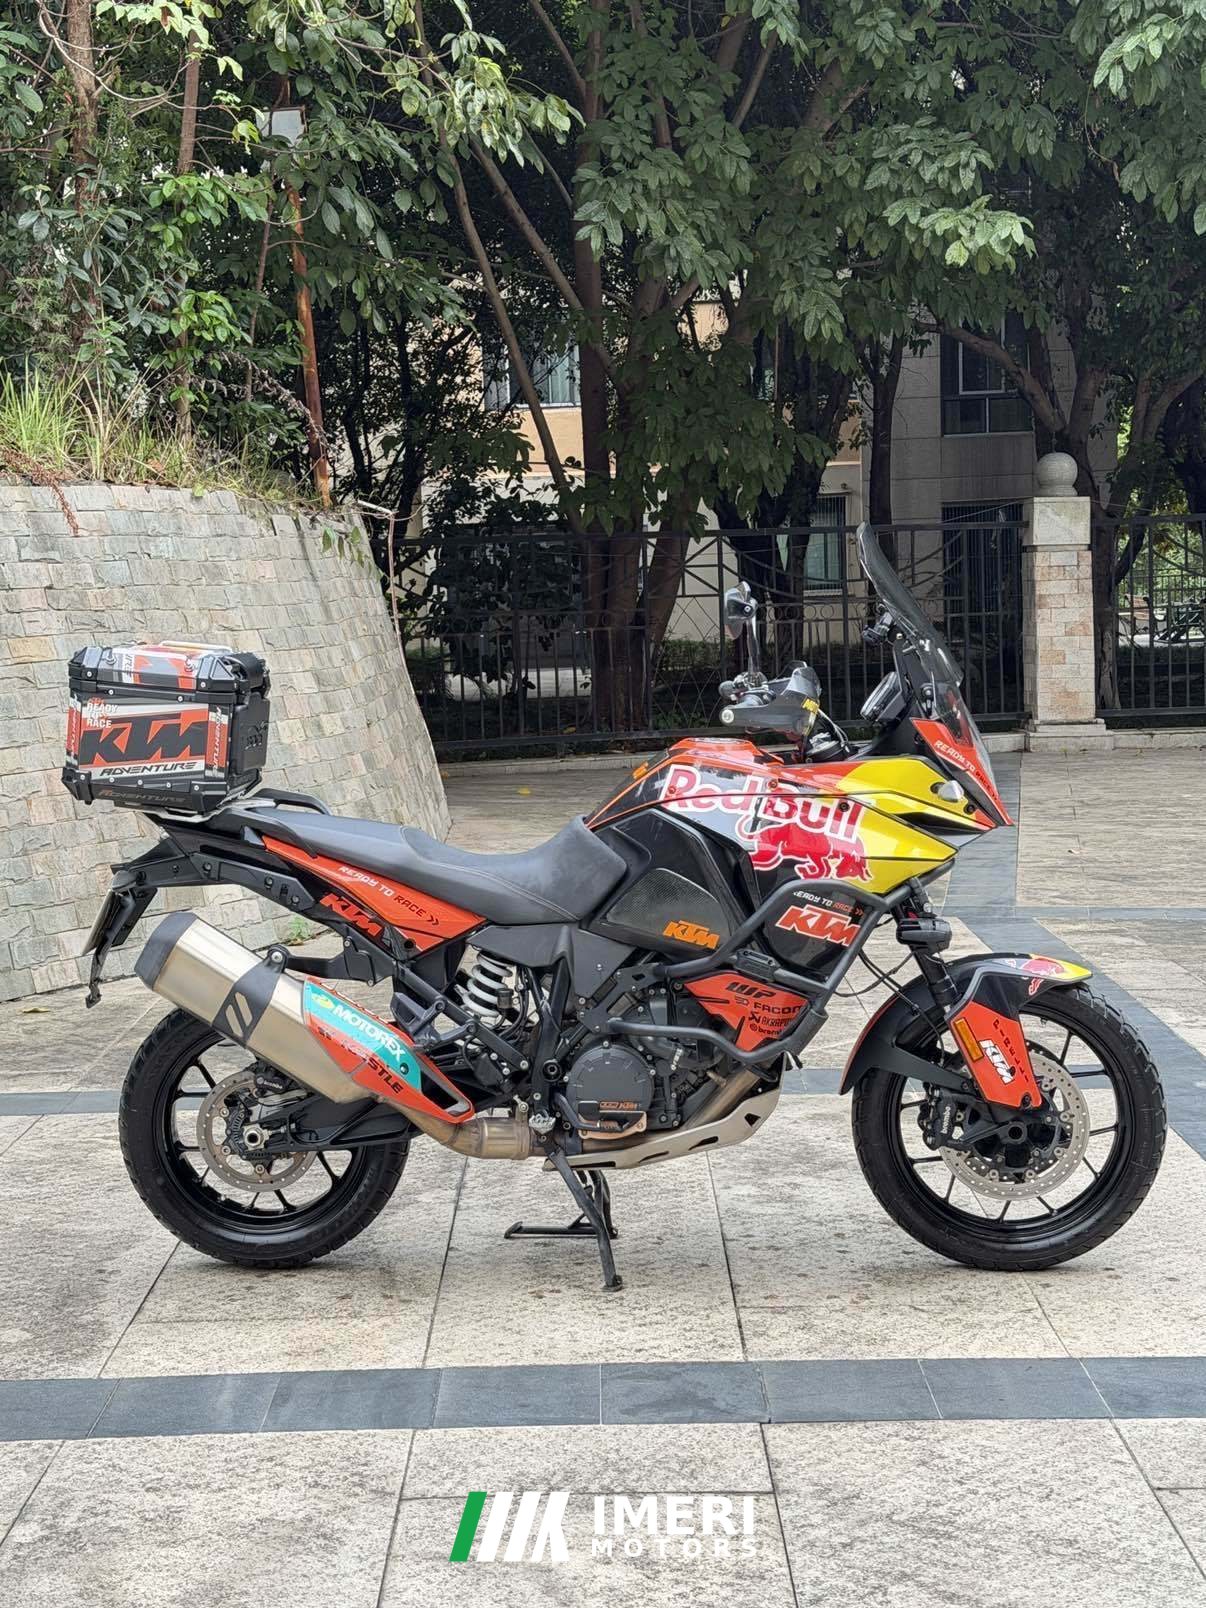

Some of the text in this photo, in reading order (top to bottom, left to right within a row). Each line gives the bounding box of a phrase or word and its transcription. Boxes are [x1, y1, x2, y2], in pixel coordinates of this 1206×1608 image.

[79, 713, 208, 765] KTM
[87, 719, 112, 728] RACE
[100, 762, 197, 776] ADVENTURE
[934, 739, 966, 763] READY
[661, 764, 866, 844] Red Bull
[337, 865, 427, 918] READY TO RACE
[821, 897, 833, 907] TO
[319, 892, 384, 938] KTM
[663, 919, 720, 950] KTM
[776, 903, 861, 948] KTM
[332, 1004, 406, 1062] MOTOREX
[992, 1018, 1029, 1083] PIRELLI
[978, 1039, 1015, 1085] KTM
[940, 1105, 951, 1134] brembo
